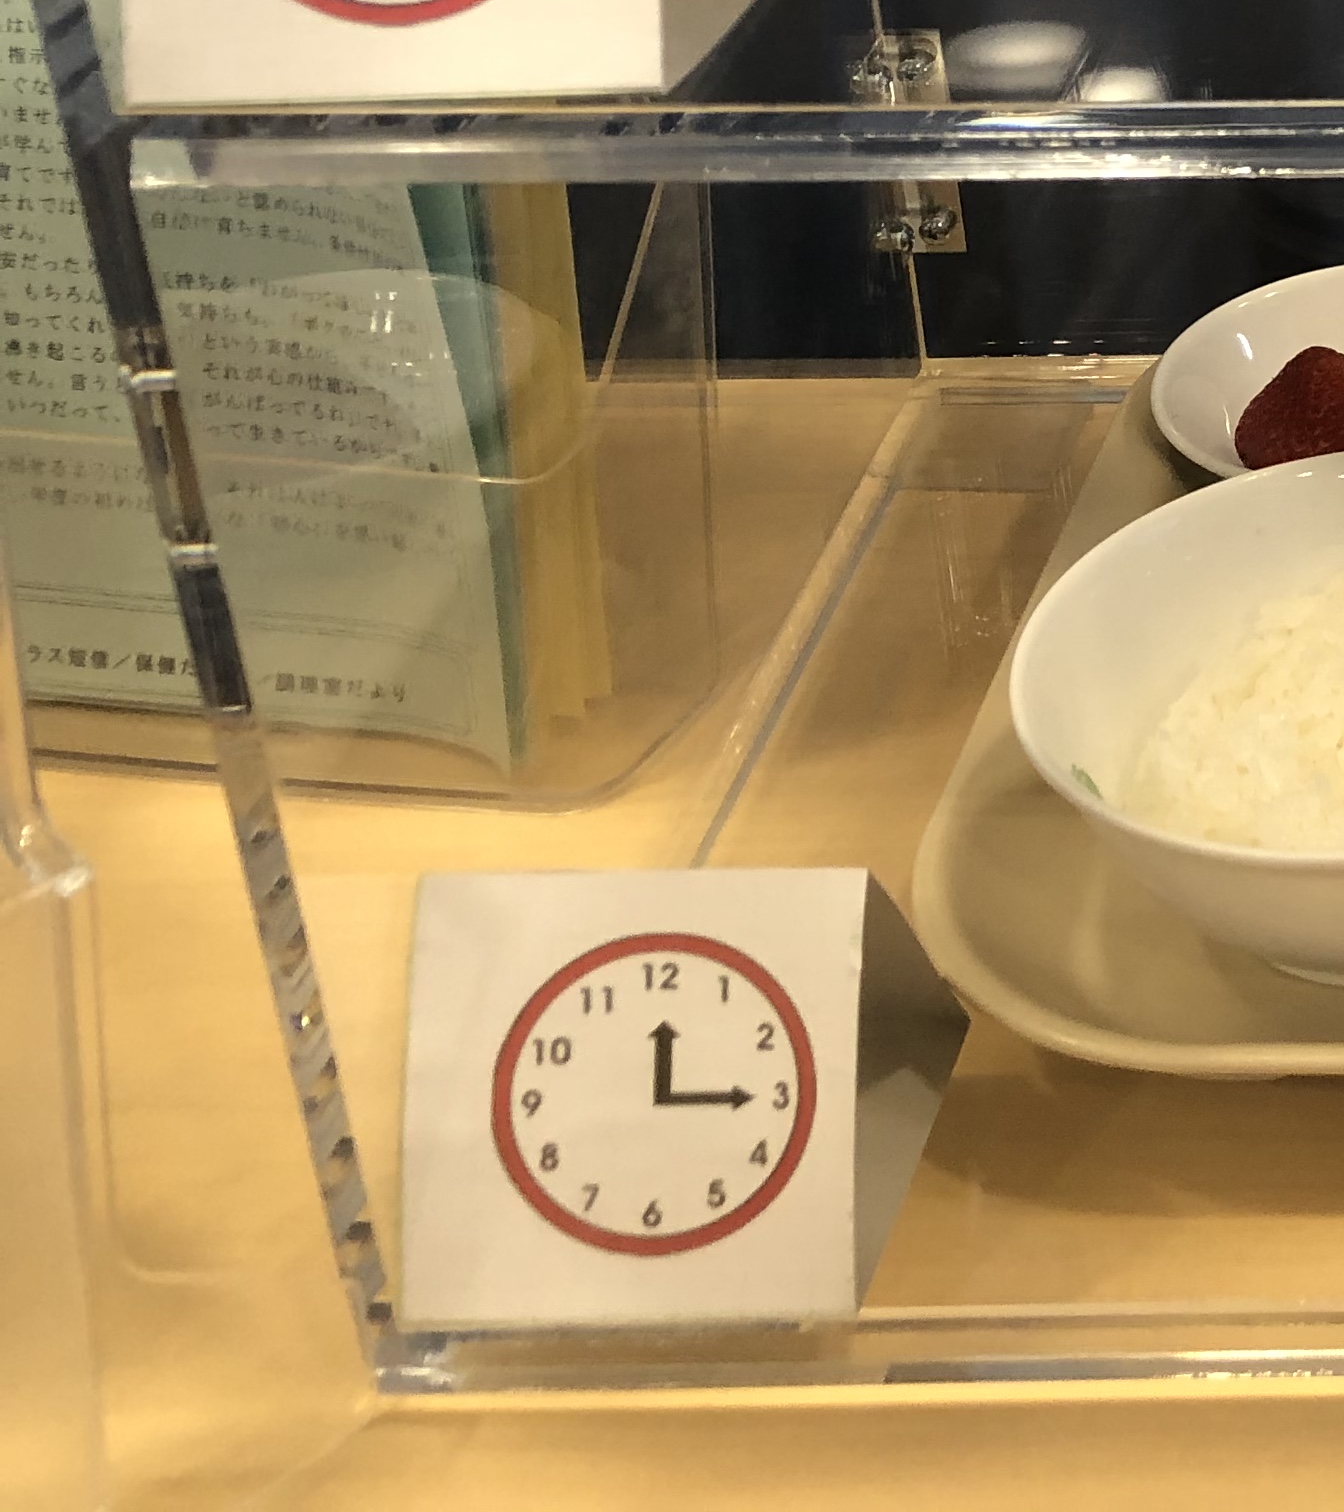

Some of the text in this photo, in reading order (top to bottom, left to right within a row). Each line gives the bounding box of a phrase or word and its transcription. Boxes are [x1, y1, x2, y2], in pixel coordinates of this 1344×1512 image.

[642, 962, 680, 991] 12
[718, 975, 731, 1003] 1
[580, 985, 614, 1015] 11
[532, 1036, 572, 1066] 10
[756, 1022, 775, 1051] 2
[520, 1089, 543, 1118] 9
[772, 1081, 790, 1112] 3
[539, 1143, 560, 1172] 8
[749, 1139, 769, 1167] 4
[581, 1183, 600, 1212] 7
[707, 1178, 727, 1209] 5
[641, 1200, 663, 1228] 6
